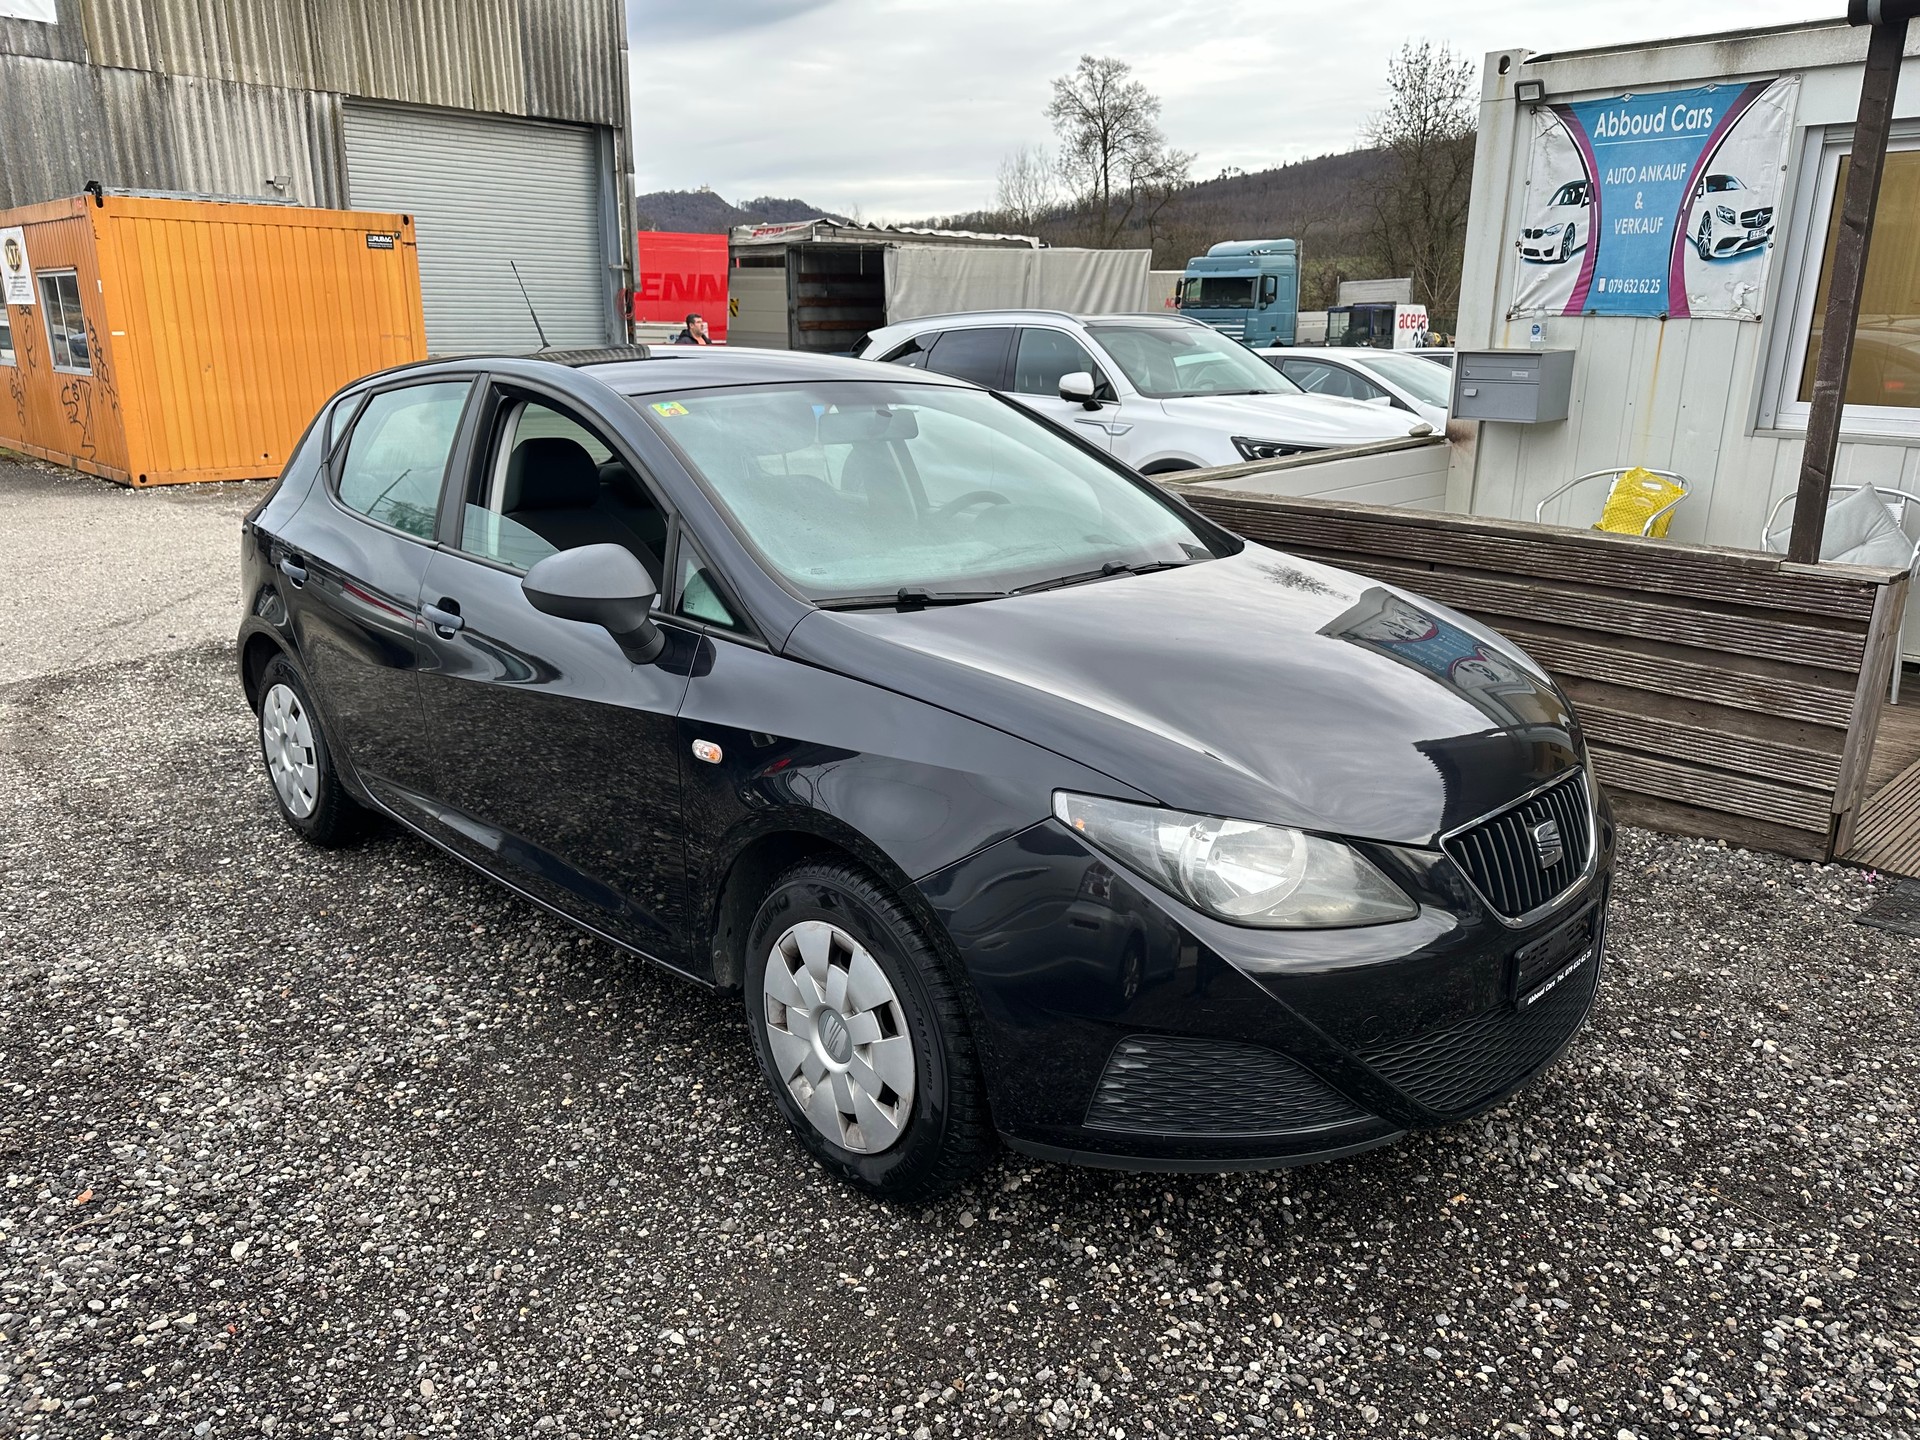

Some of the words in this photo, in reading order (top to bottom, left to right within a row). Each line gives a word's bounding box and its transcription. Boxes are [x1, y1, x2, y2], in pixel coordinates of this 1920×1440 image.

[1594, 106, 1666, 138] Abboud
[1671, 104, 1713, 131] Cars
[1605, 166, 1636, 185] AUTO
[1638, 163, 1687, 183] ANKAUF
[1635, 191, 1643, 210] &
[1614, 217, 1664, 235] VERKAUF
[1608, 278, 1623, 293] 079
[1624, 279, 1638, 293] 632
[1639, 279, 1650, 293] 62
[1650, 278, 1660, 293] 25
